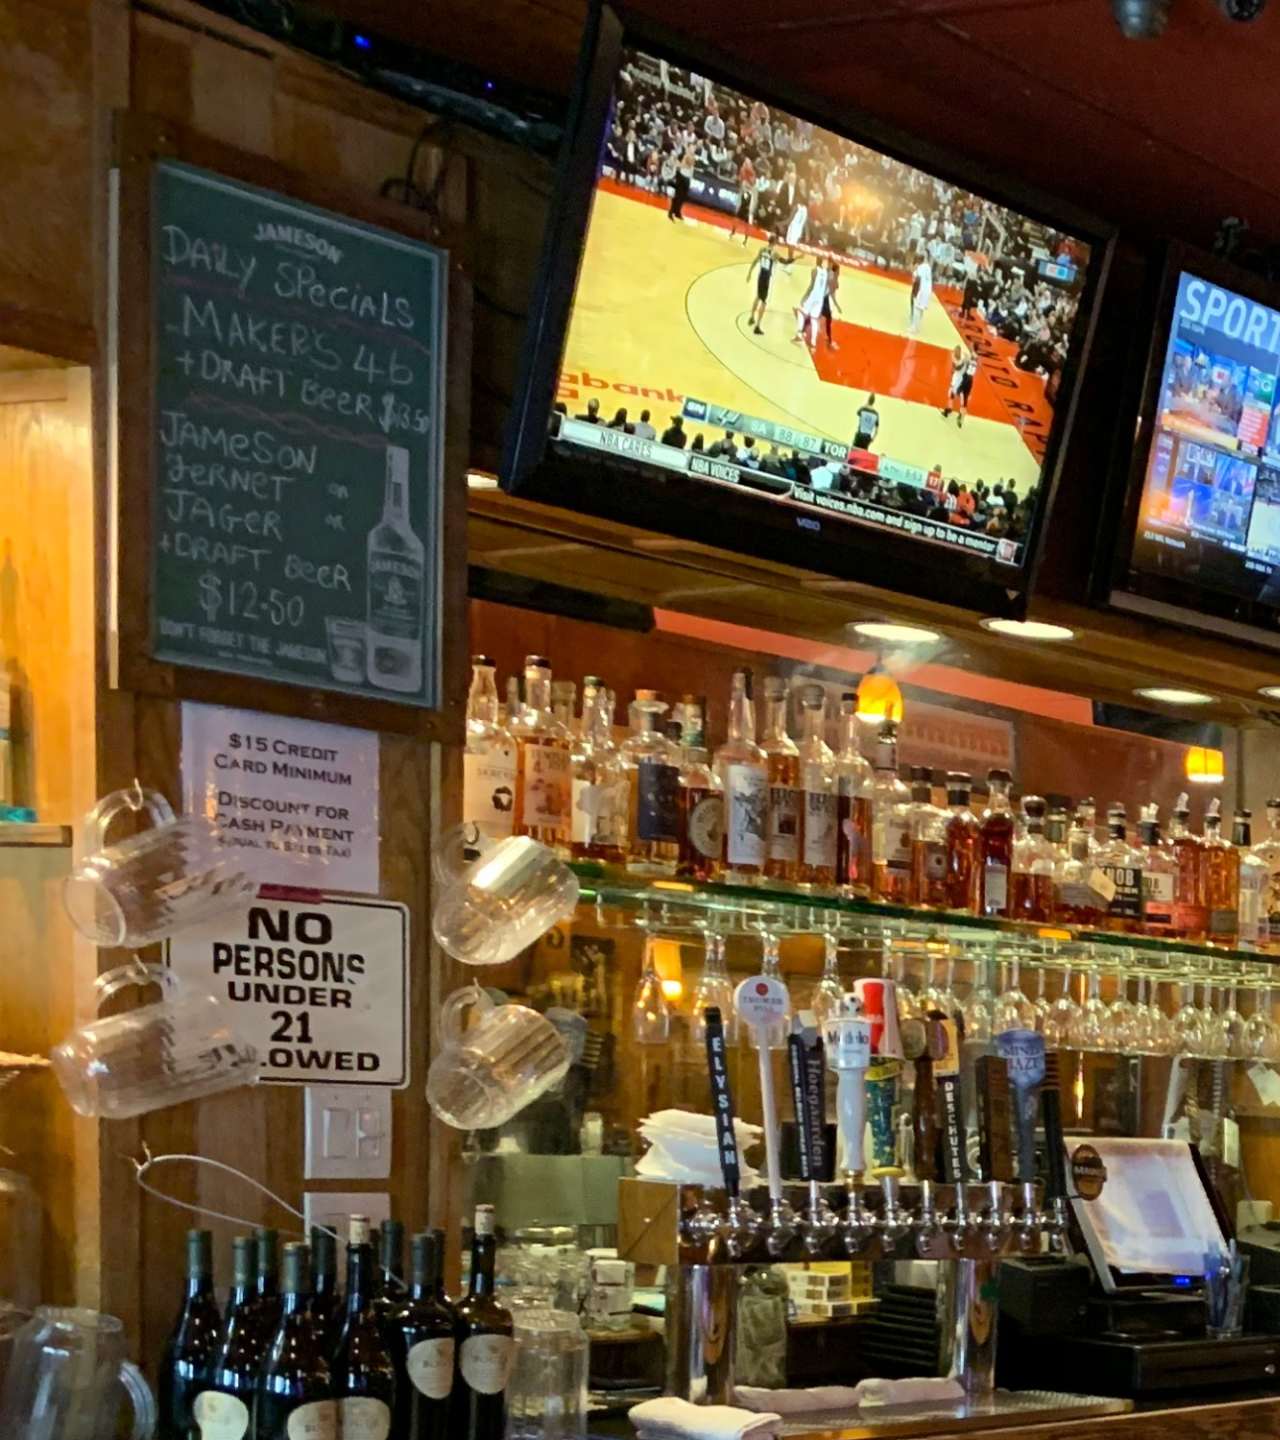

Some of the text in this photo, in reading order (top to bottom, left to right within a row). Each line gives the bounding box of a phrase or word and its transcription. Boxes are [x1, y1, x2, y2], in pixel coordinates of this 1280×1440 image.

[163, 225, 257, 291] DAILY
[254, 223, 343, 264] JAMESON
[823, 443, 848, 459] TOR
[690, 456, 741, 484] NBA VOICES
[228, 732, 339, 762] $15 CREDIT
[213, 753, 353, 786] CARD MINIMUM
[217, 790, 350, 820] DISCOUNT FOR
[247, 906, 333, 946] NO
[213, 941, 366, 985] PERSONS
[228, 981, 352, 1009] UNDER
[270, 1010, 314, 1044] 21
[240, 1046, 381, 1073] OWED
[711, 1036, 737, 1166] ELYSIAN
[806, 1058, 826, 1168] Hoegaarden
[943, 1080, 962, 1180] DESCHUTES
